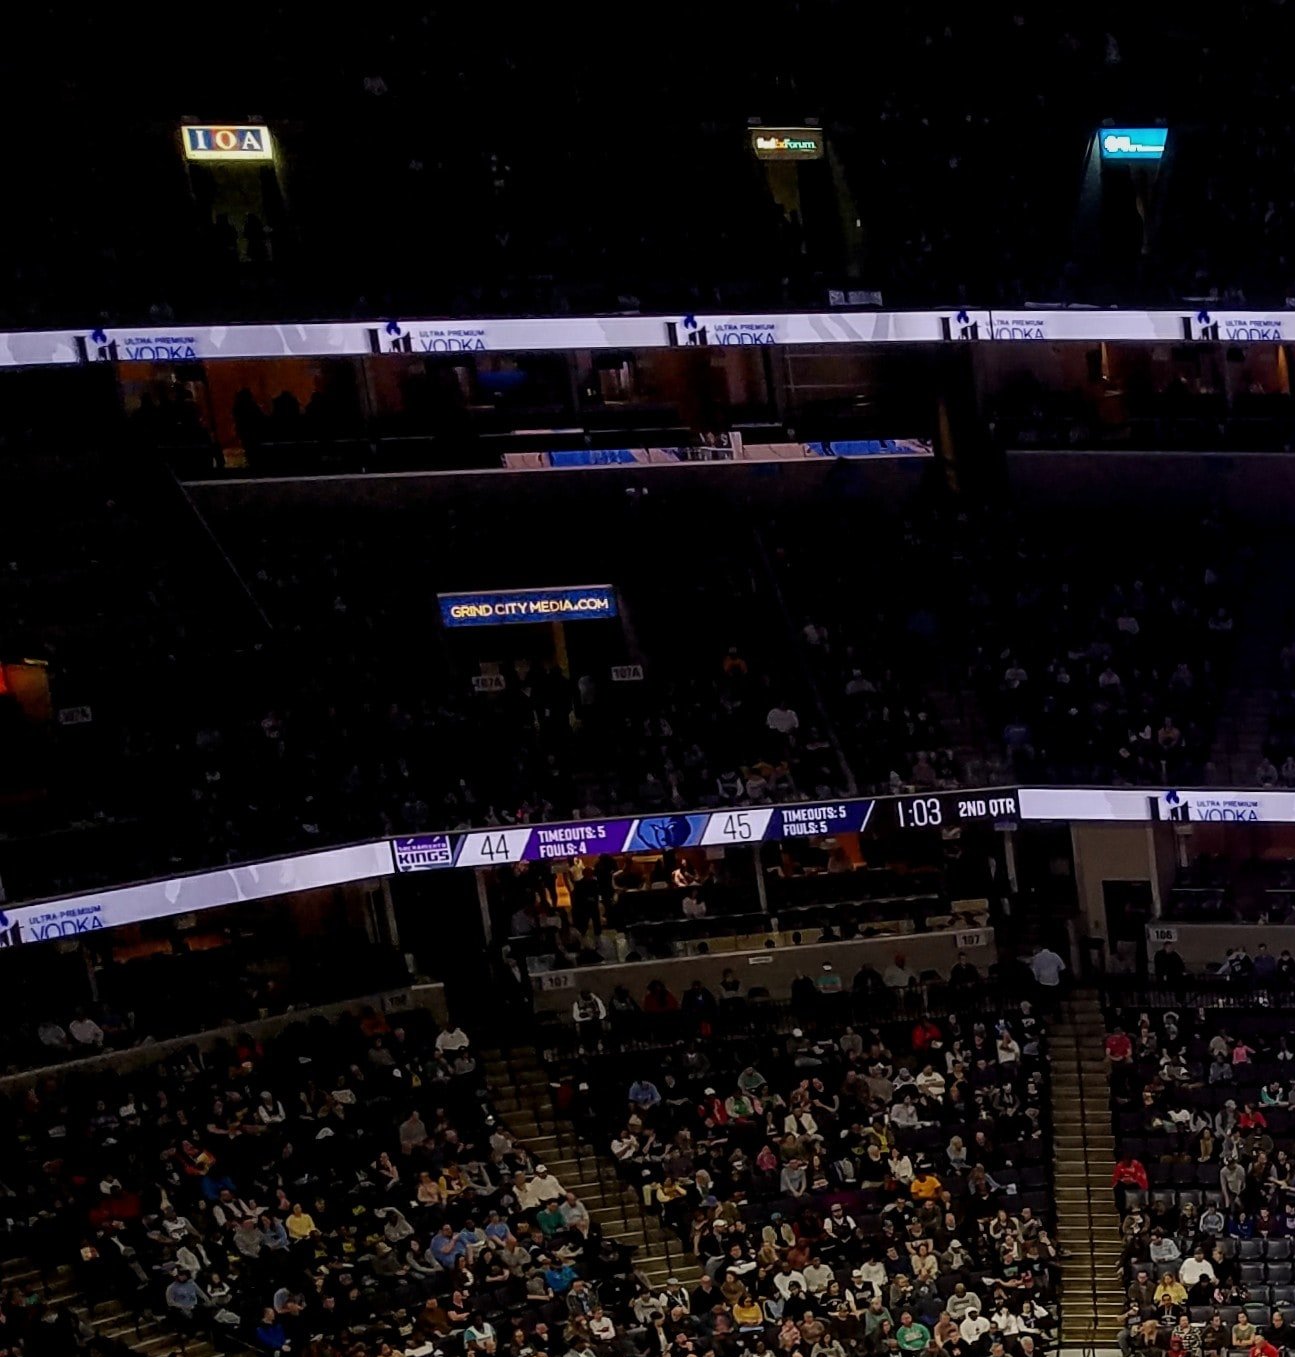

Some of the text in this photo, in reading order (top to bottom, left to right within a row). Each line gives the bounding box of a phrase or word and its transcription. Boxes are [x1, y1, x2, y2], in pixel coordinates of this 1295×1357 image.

[194, 130, 261, 151] IOA
[715, 332, 776, 345] VODKA
[125, 345, 197, 360] VODKA
[450, 597, 609, 619] GRIND CITY MEDIA.COM
[781, 805, 847, 823] TIMEOUTS: 5
[898, 797, 942, 828] 1:03
[958, 798, 1017, 818] 2ND QTR
[537, 825, 606, 843] TIMEOUTS: 5
[723, 812, 751, 840] 45
[783, 822, 828, 837] FOULS: 5
[480, 833, 510, 861] 44
[539, 841, 587, 858] FOULS: 4
[397, 850, 451, 865] KINGS
